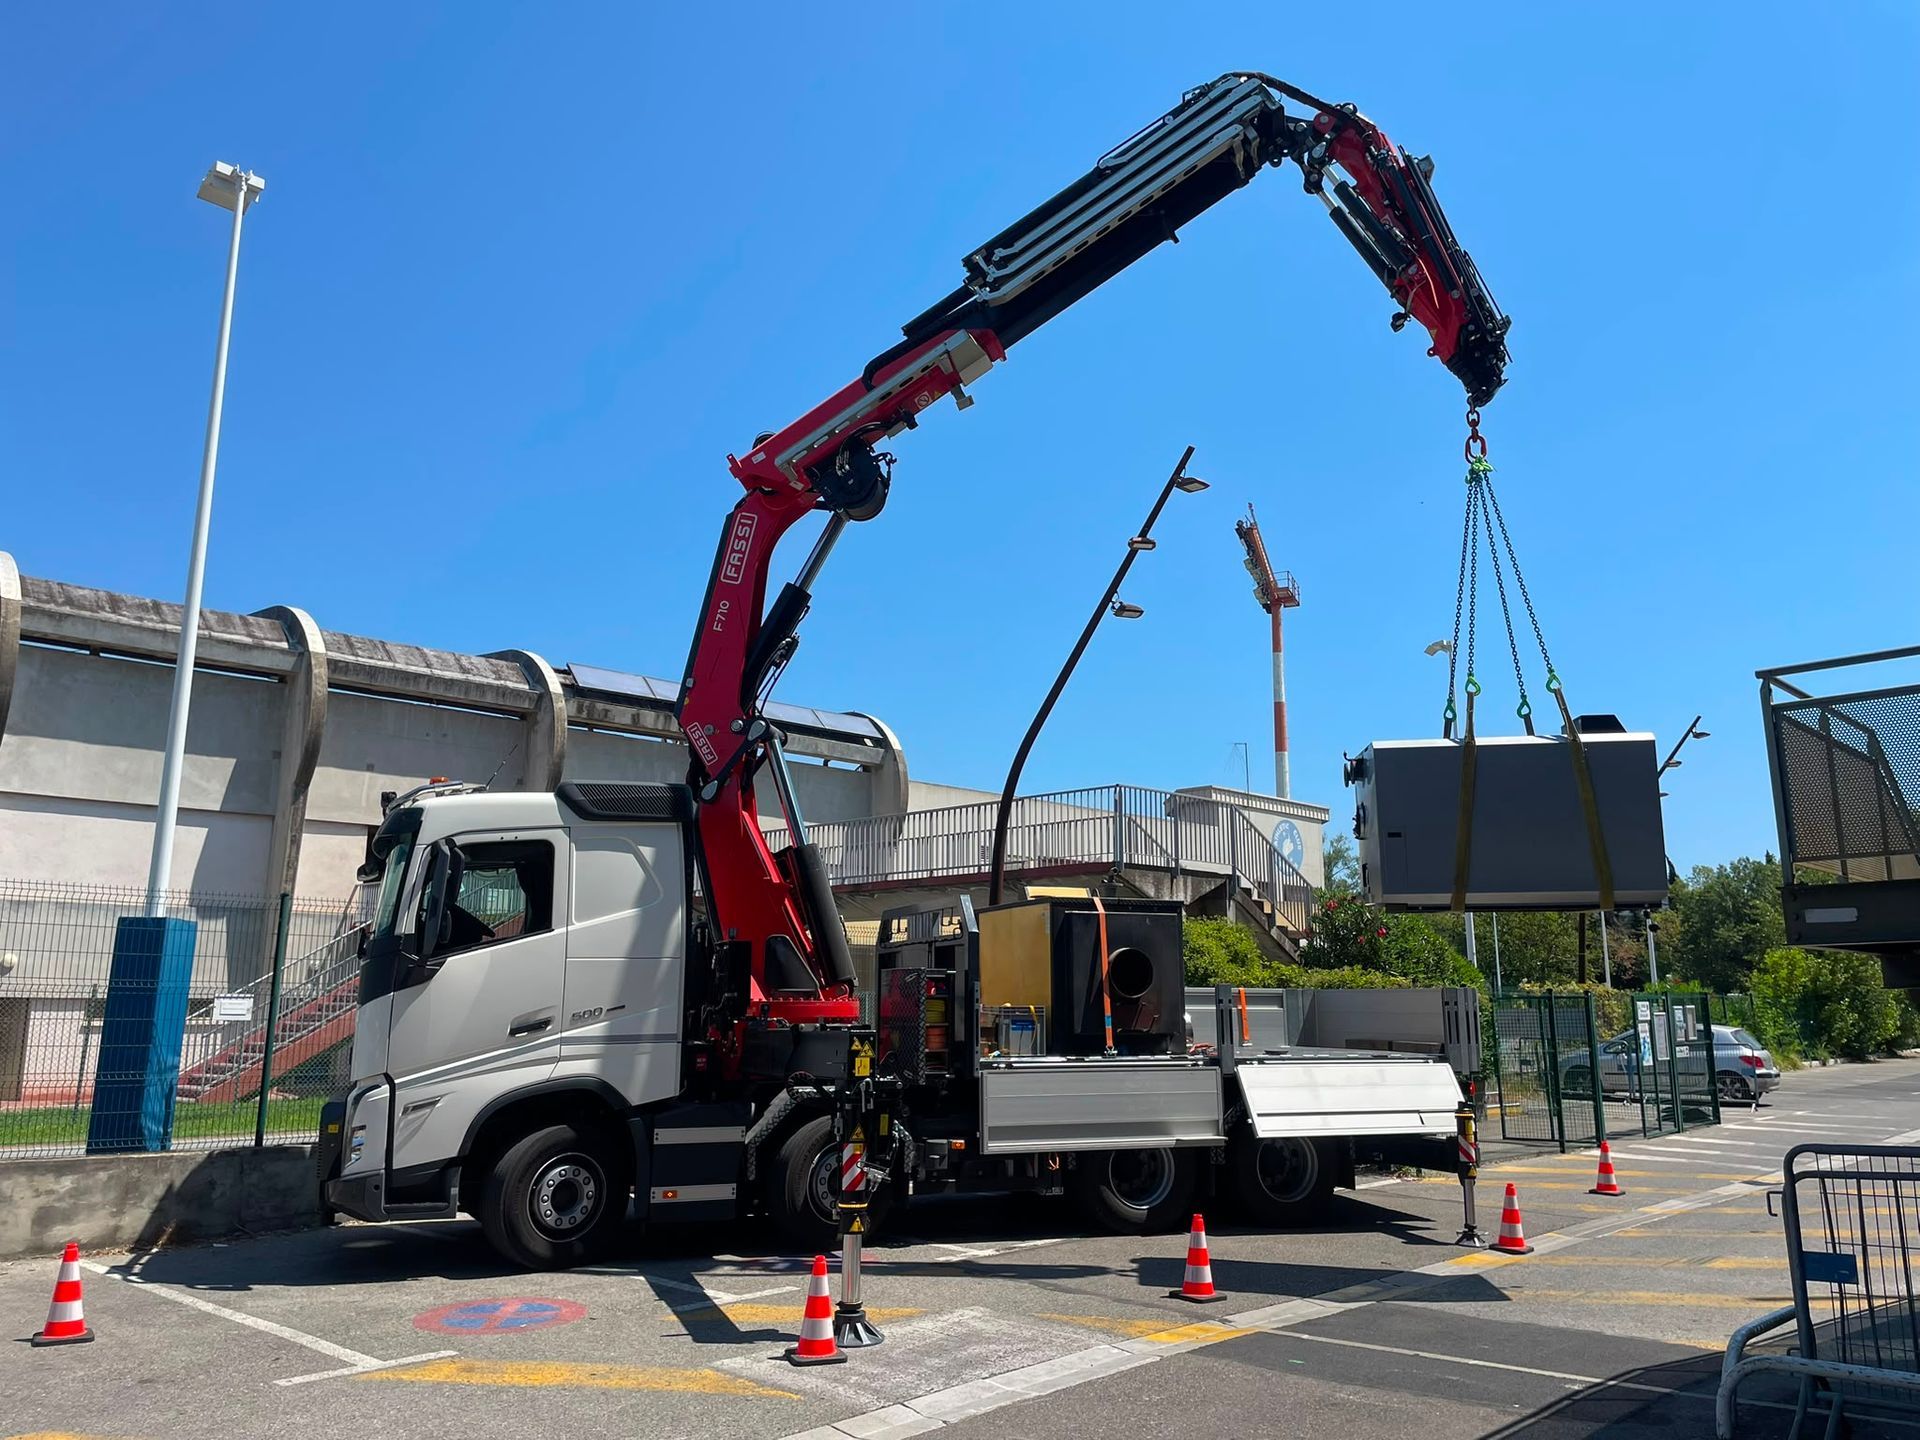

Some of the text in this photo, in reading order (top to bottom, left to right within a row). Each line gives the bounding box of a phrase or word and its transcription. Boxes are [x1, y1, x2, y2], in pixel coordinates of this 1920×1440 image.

[726, 519, 753, 578] FASSI
[712, 600, 730, 632] F710
[690, 726, 715, 761] FASSI
[572, 1006, 604, 1021] 500
